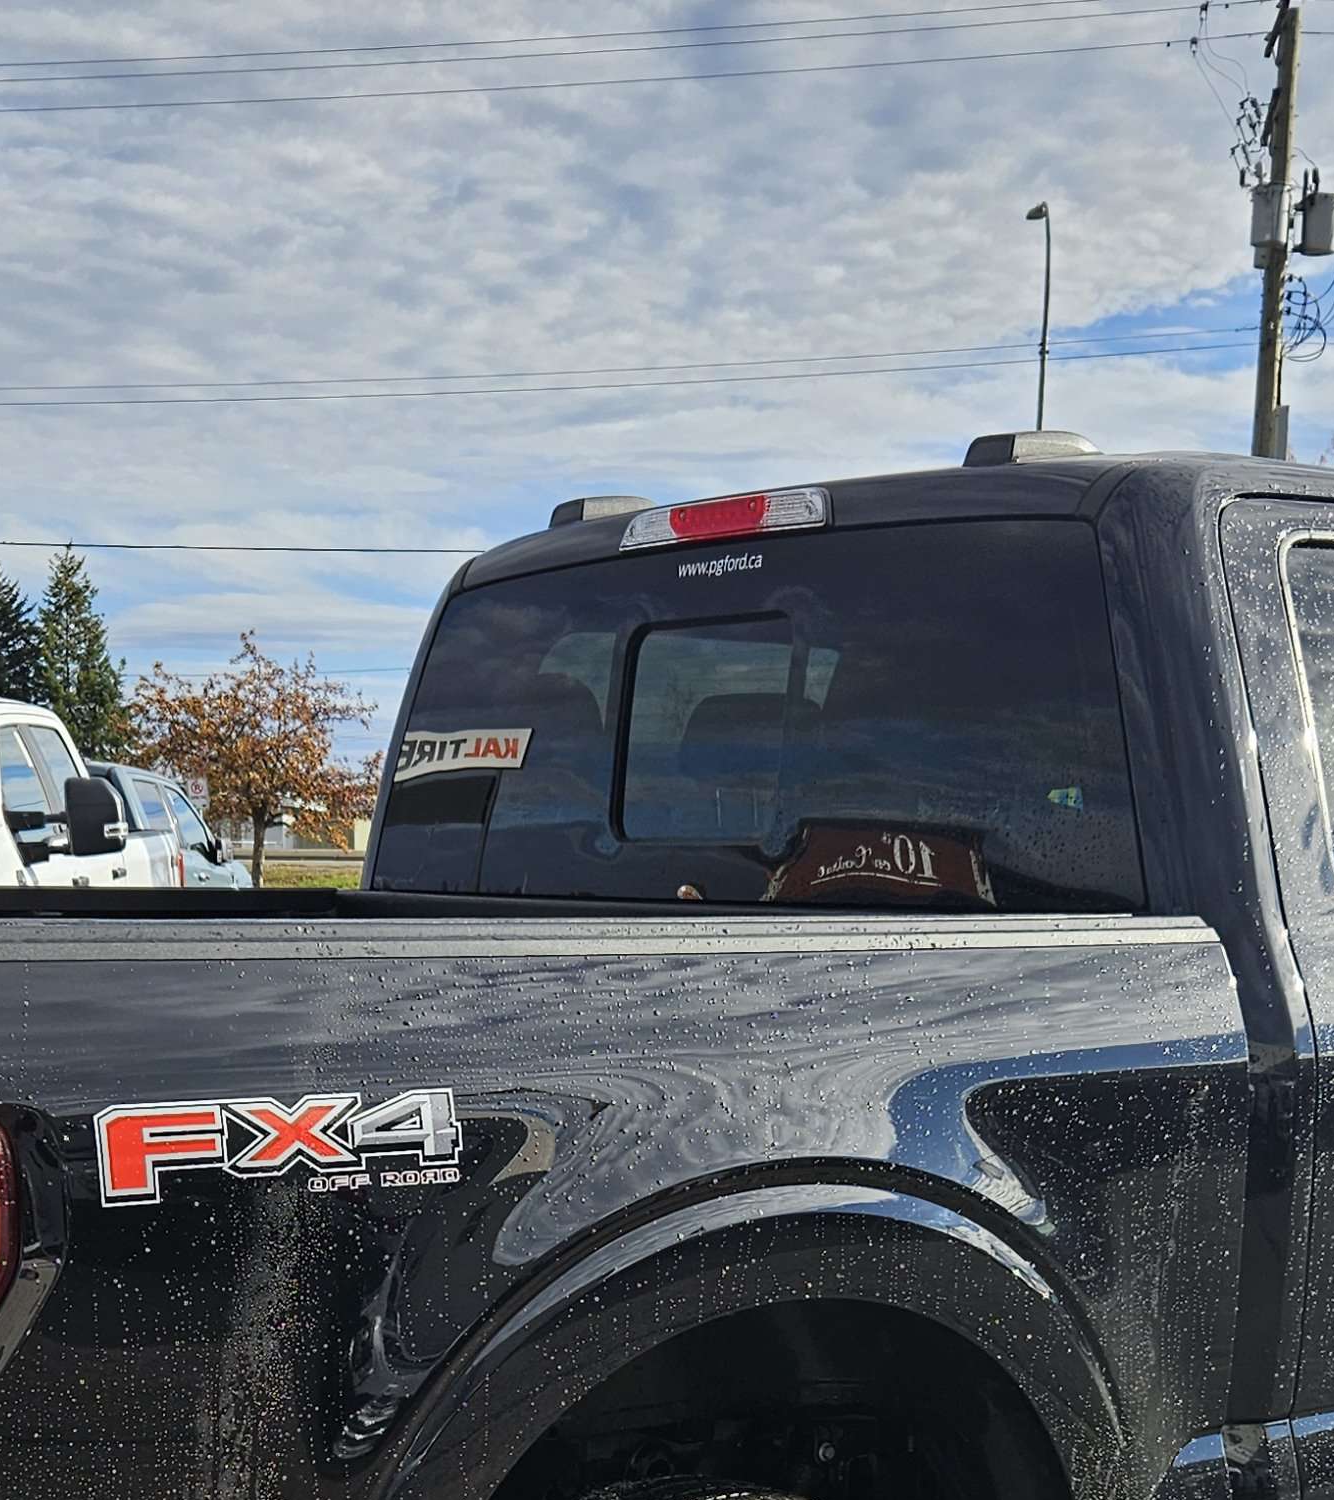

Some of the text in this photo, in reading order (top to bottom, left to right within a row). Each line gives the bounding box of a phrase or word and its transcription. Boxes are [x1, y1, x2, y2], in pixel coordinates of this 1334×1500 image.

[678, 553, 763, 578] www.pgford.ca
[93, 1088, 463, 1208] FX4
[308, 1167, 461, 1192] OFF ROAD
